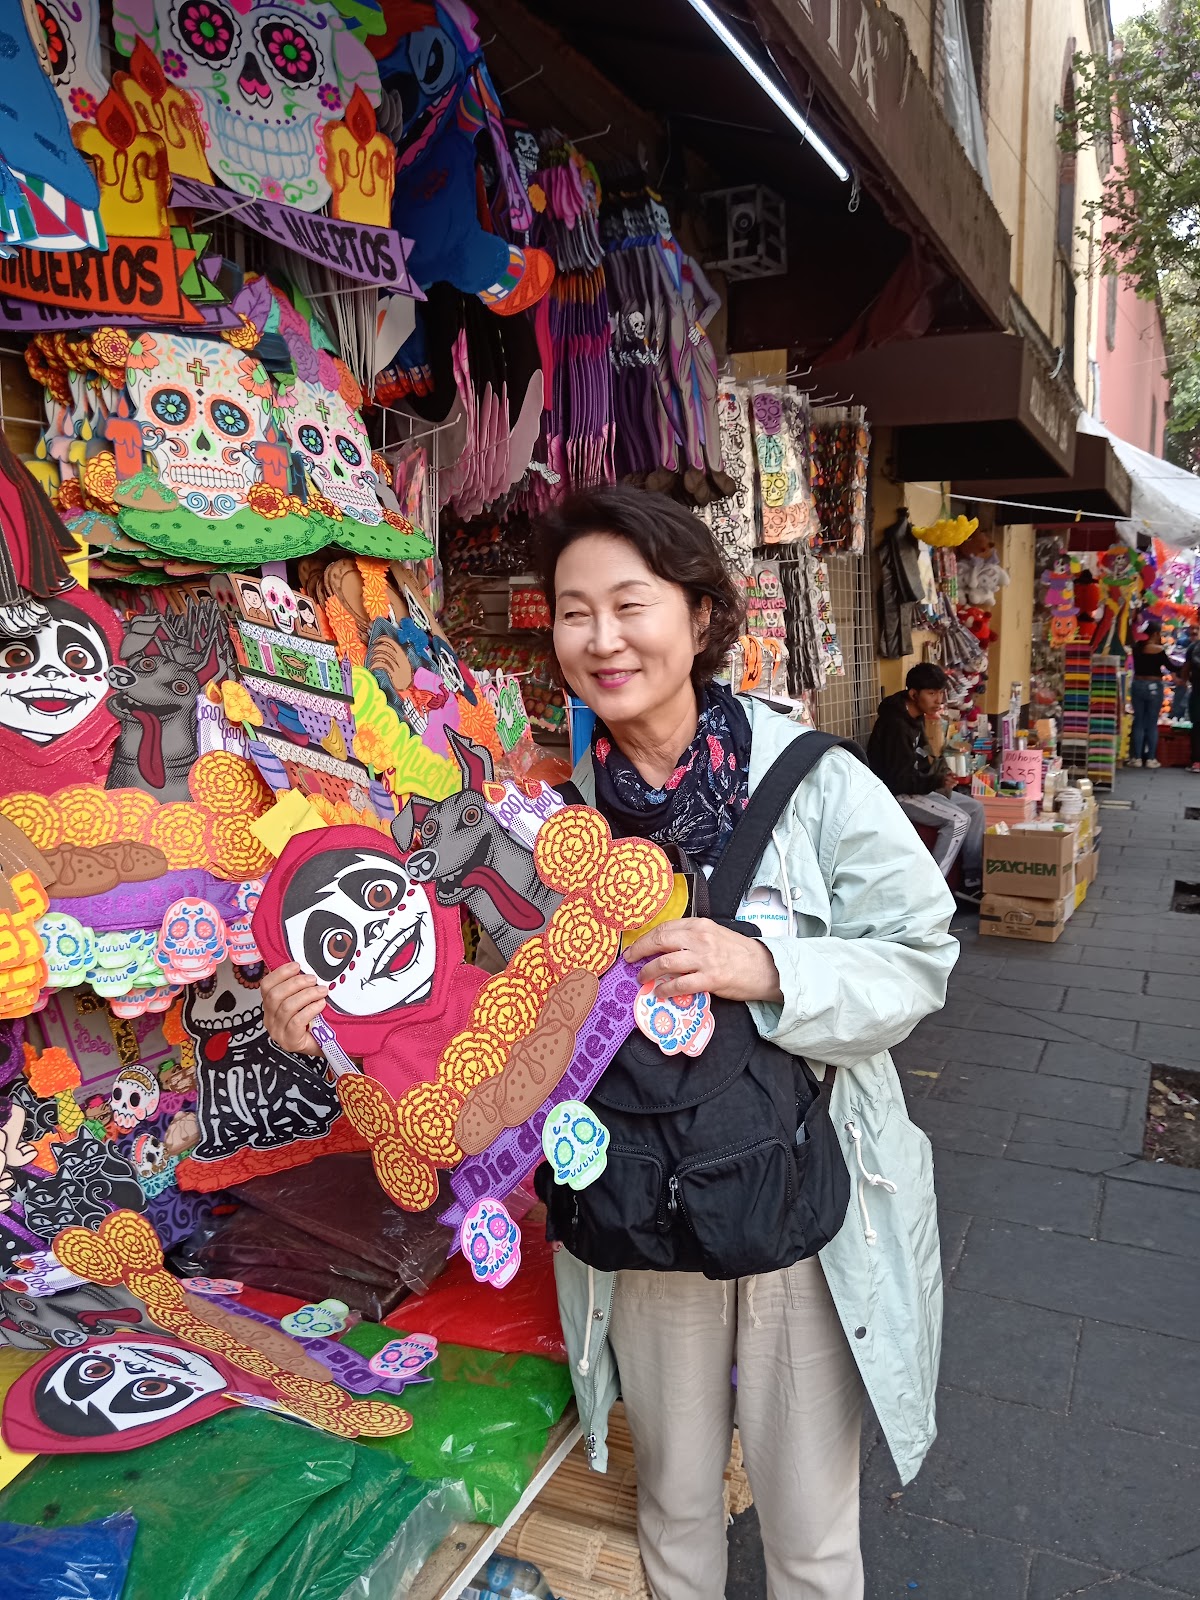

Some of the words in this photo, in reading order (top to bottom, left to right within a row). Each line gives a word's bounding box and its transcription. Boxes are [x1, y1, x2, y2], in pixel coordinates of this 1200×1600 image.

[233, 196, 286, 240] DE
[280, 209, 398, 281] MUERTOS
[0, 245, 163, 306] MUERTOS
[985, 859, 1057, 876] POLYCHEM
[463, 1150, 518, 1198] Día
[326, 1350, 374, 1386] Día
